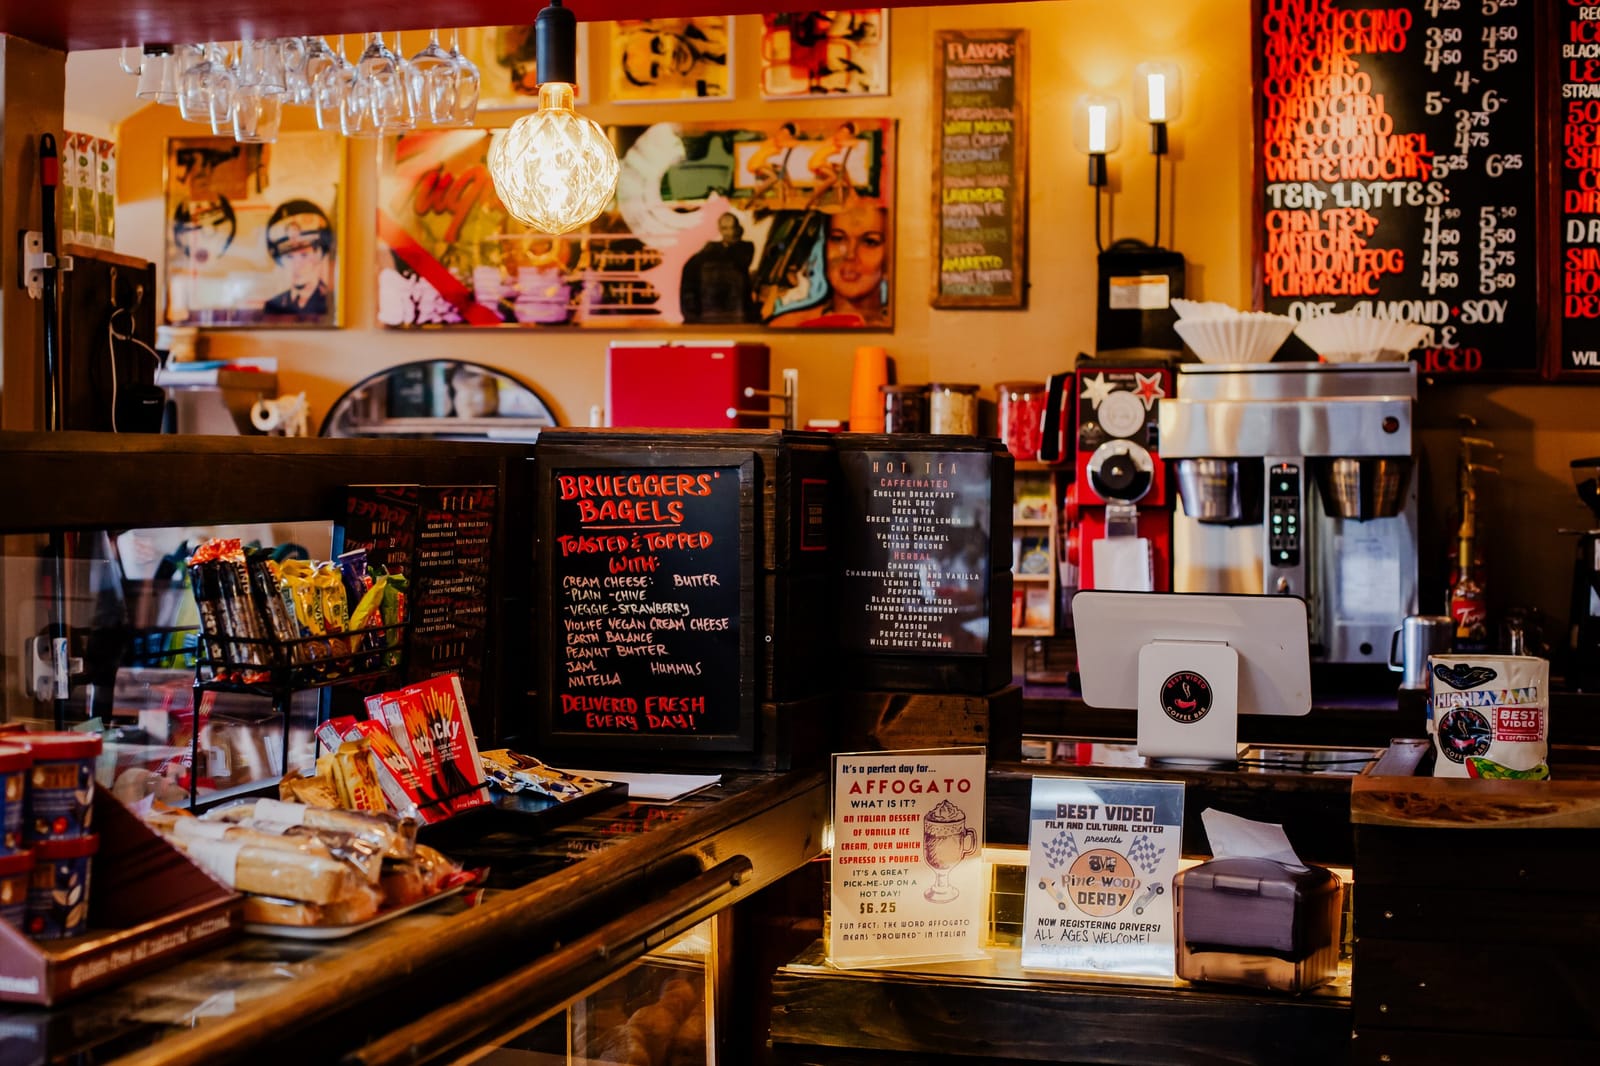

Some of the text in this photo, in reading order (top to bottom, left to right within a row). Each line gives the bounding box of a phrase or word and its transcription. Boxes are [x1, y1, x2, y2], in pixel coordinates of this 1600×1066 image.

[1486, 153, 1522, 177] 6.25
[1461, 300, 1508, 324] SOY
[873, 462, 957, 474] HOT TEA
[558, 471, 720, 500] BRUEGGERS'
[880, 478, 949, 488] CAFFEINATED
[873, 490, 955, 499] ENGLISH BREAKFAST
[892, 499, 911, 507] EARL
[577, 499, 685, 523] BAGELS
[892, 507, 935, 516] GREEN TEA
[865, 515, 890, 523] GREEN
[894, 515, 909, 523] TEA
[913, 516, 931, 524] WITH
[891, 524, 936, 533] CHAI SPICE
[876, 533, 950, 542] VANILLA CARAMEL
[557, 531, 714, 556] TOASTED TOPPED
[882, 541, 910, 549] CITRUS
[893, 551, 931, 561] HERBAL
[609, 555, 660, 574] WITH:
[563, 573, 720, 588] CREAM CHEESE: BUTTER
[945, 572, 980, 580] VANILLA
[883, 579, 909, 587] LEMON
[865, 604, 906, 613] CINNAMON
[879, 613, 943, 622] RED RASPBERRY
[564, 617, 729, 631] VIOLIFE VEGAN CREAM CHEESE
[894, 622, 928, 630] PASSION
[566, 631, 653, 645] EARTH BALANCE
[879, 630, 943, 639] PERFECT PEACH
[870, 639, 889, 647] WILD
[892, 639, 918, 647] SWEET
[566, 644, 669, 659] PEANUT BUTTER
[566, 660, 702, 676] JAM HUMMUS
[569, 672, 622, 688] NUTELLA
[1185, 674, 1207, 689] VIDEO
[560, 693, 705, 714] DELIVERED FRESH
[1167, 706, 1207, 721] COFFEE BAR
[1500, 710, 1538, 720] BEST
[586, 712, 697, 730] EVERY DAY!
[1502, 720, 1536, 728] VIDEO
[842, 764, 859, 774] It's
[859, 766, 865, 774] a
[866, 763, 898, 775] perfect
[898, 764, 914, 775] day
[849, 778, 971, 795] AFFOGATO
[850, 799, 916, 809] WHAT IS IT?
[1056, 803, 1155, 823] BEST VIDEO
[857, 814, 888, 823] ITALIAN
[889, 814, 920, 822] DESSERT
[853, 828, 910, 837] OF VANILLA ICE
[1045, 821, 1164, 834] FILM AND CULTURAL CENTER
[1084, 835, 1123, 845] presents
[873, 841, 893, 850] OVER
[896, 841, 921, 849] WHICH
[839, 856, 877, 865] ESPRESSO
[879, 856, 886, 864] IS
[853, 869, 869, 877] IT'S
[880, 868, 909, 876] GREAT
[843, 879, 894, 887] PICK-ME-UP
[860, 890, 878, 898] HOT
[1077, 891, 1127, 906] DERBY
[859, 902, 897, 914] $6.25
[839, 922, 855, 930] FUN
[883, 921, 898, 929] THE
[900, 920, 925, 928] WORD
[1038, 918, 1161, 933] NOW REGISTERING DRIVERS!
[842, 933, 869, 941] MEANS
[1034, 929, 1151, 945] ALL AGES WELCOME!
